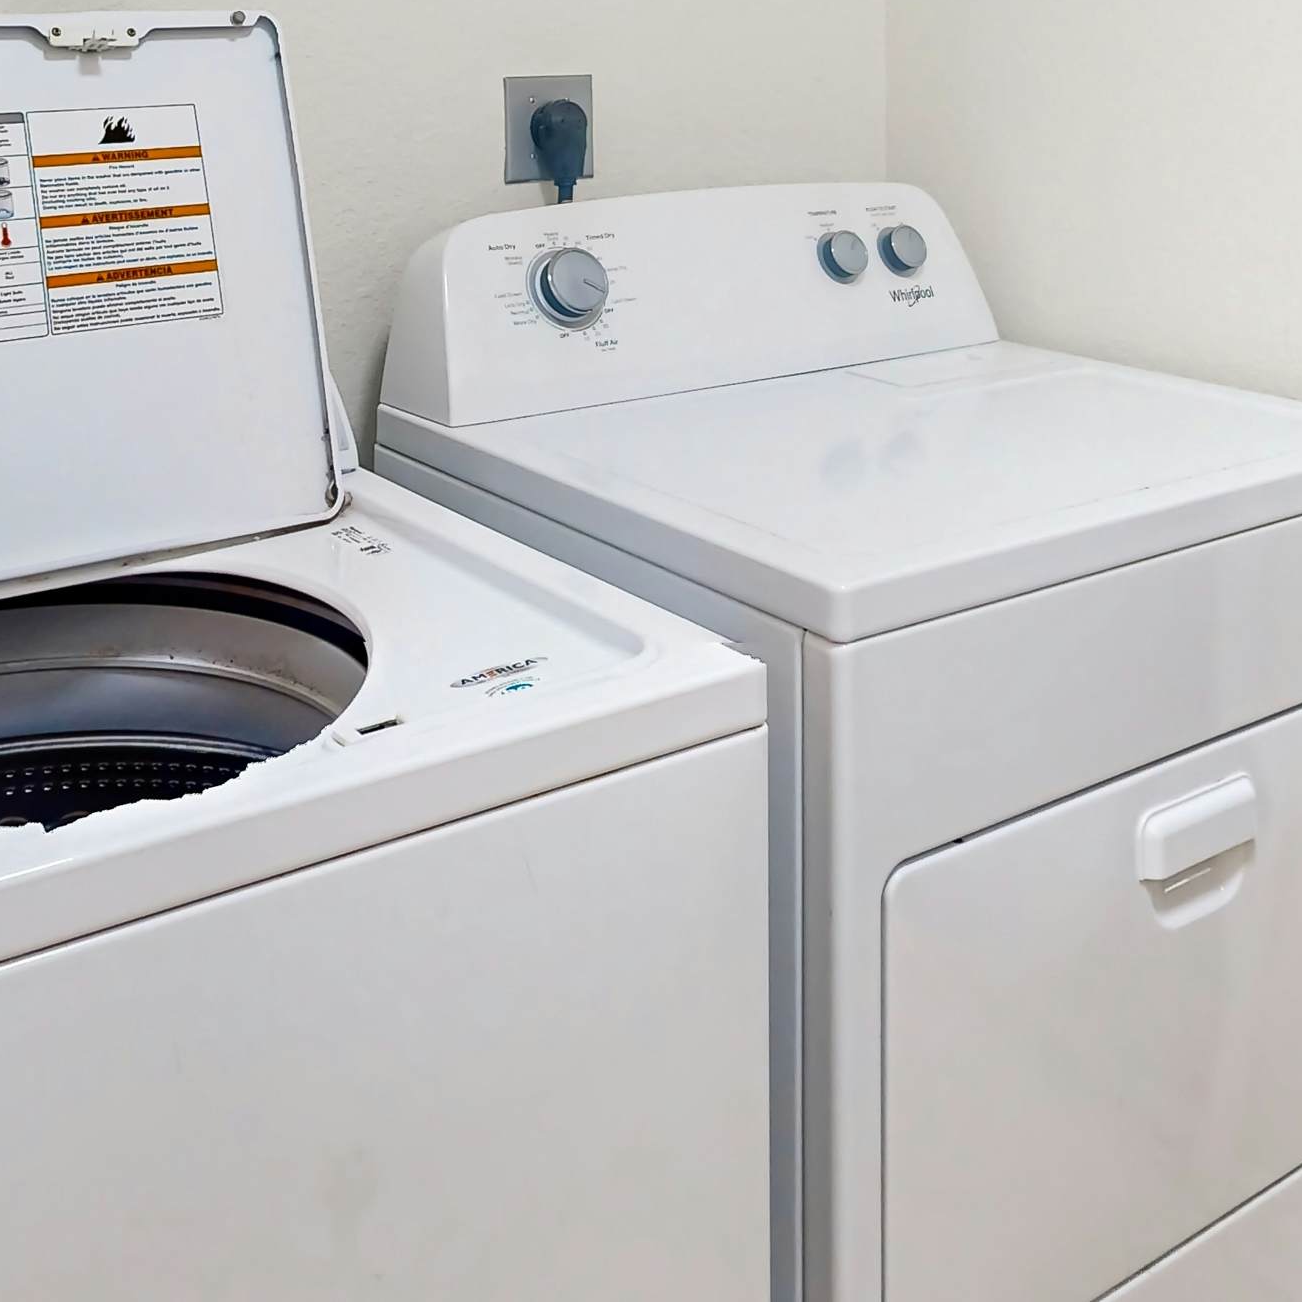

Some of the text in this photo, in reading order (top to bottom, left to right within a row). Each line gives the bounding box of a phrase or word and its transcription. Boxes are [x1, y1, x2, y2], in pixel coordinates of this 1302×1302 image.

[101, 151, 149, 161] WARNING
[92, 209, 174, 223] AVERTISSEMENT
[504, 243, 516, 251] Dry
[107, 266, 173, 280] ADVERTENCIA
[888, 284, 935, 307] Whirlpool
[460, 658, 538, 686] AMERICA
